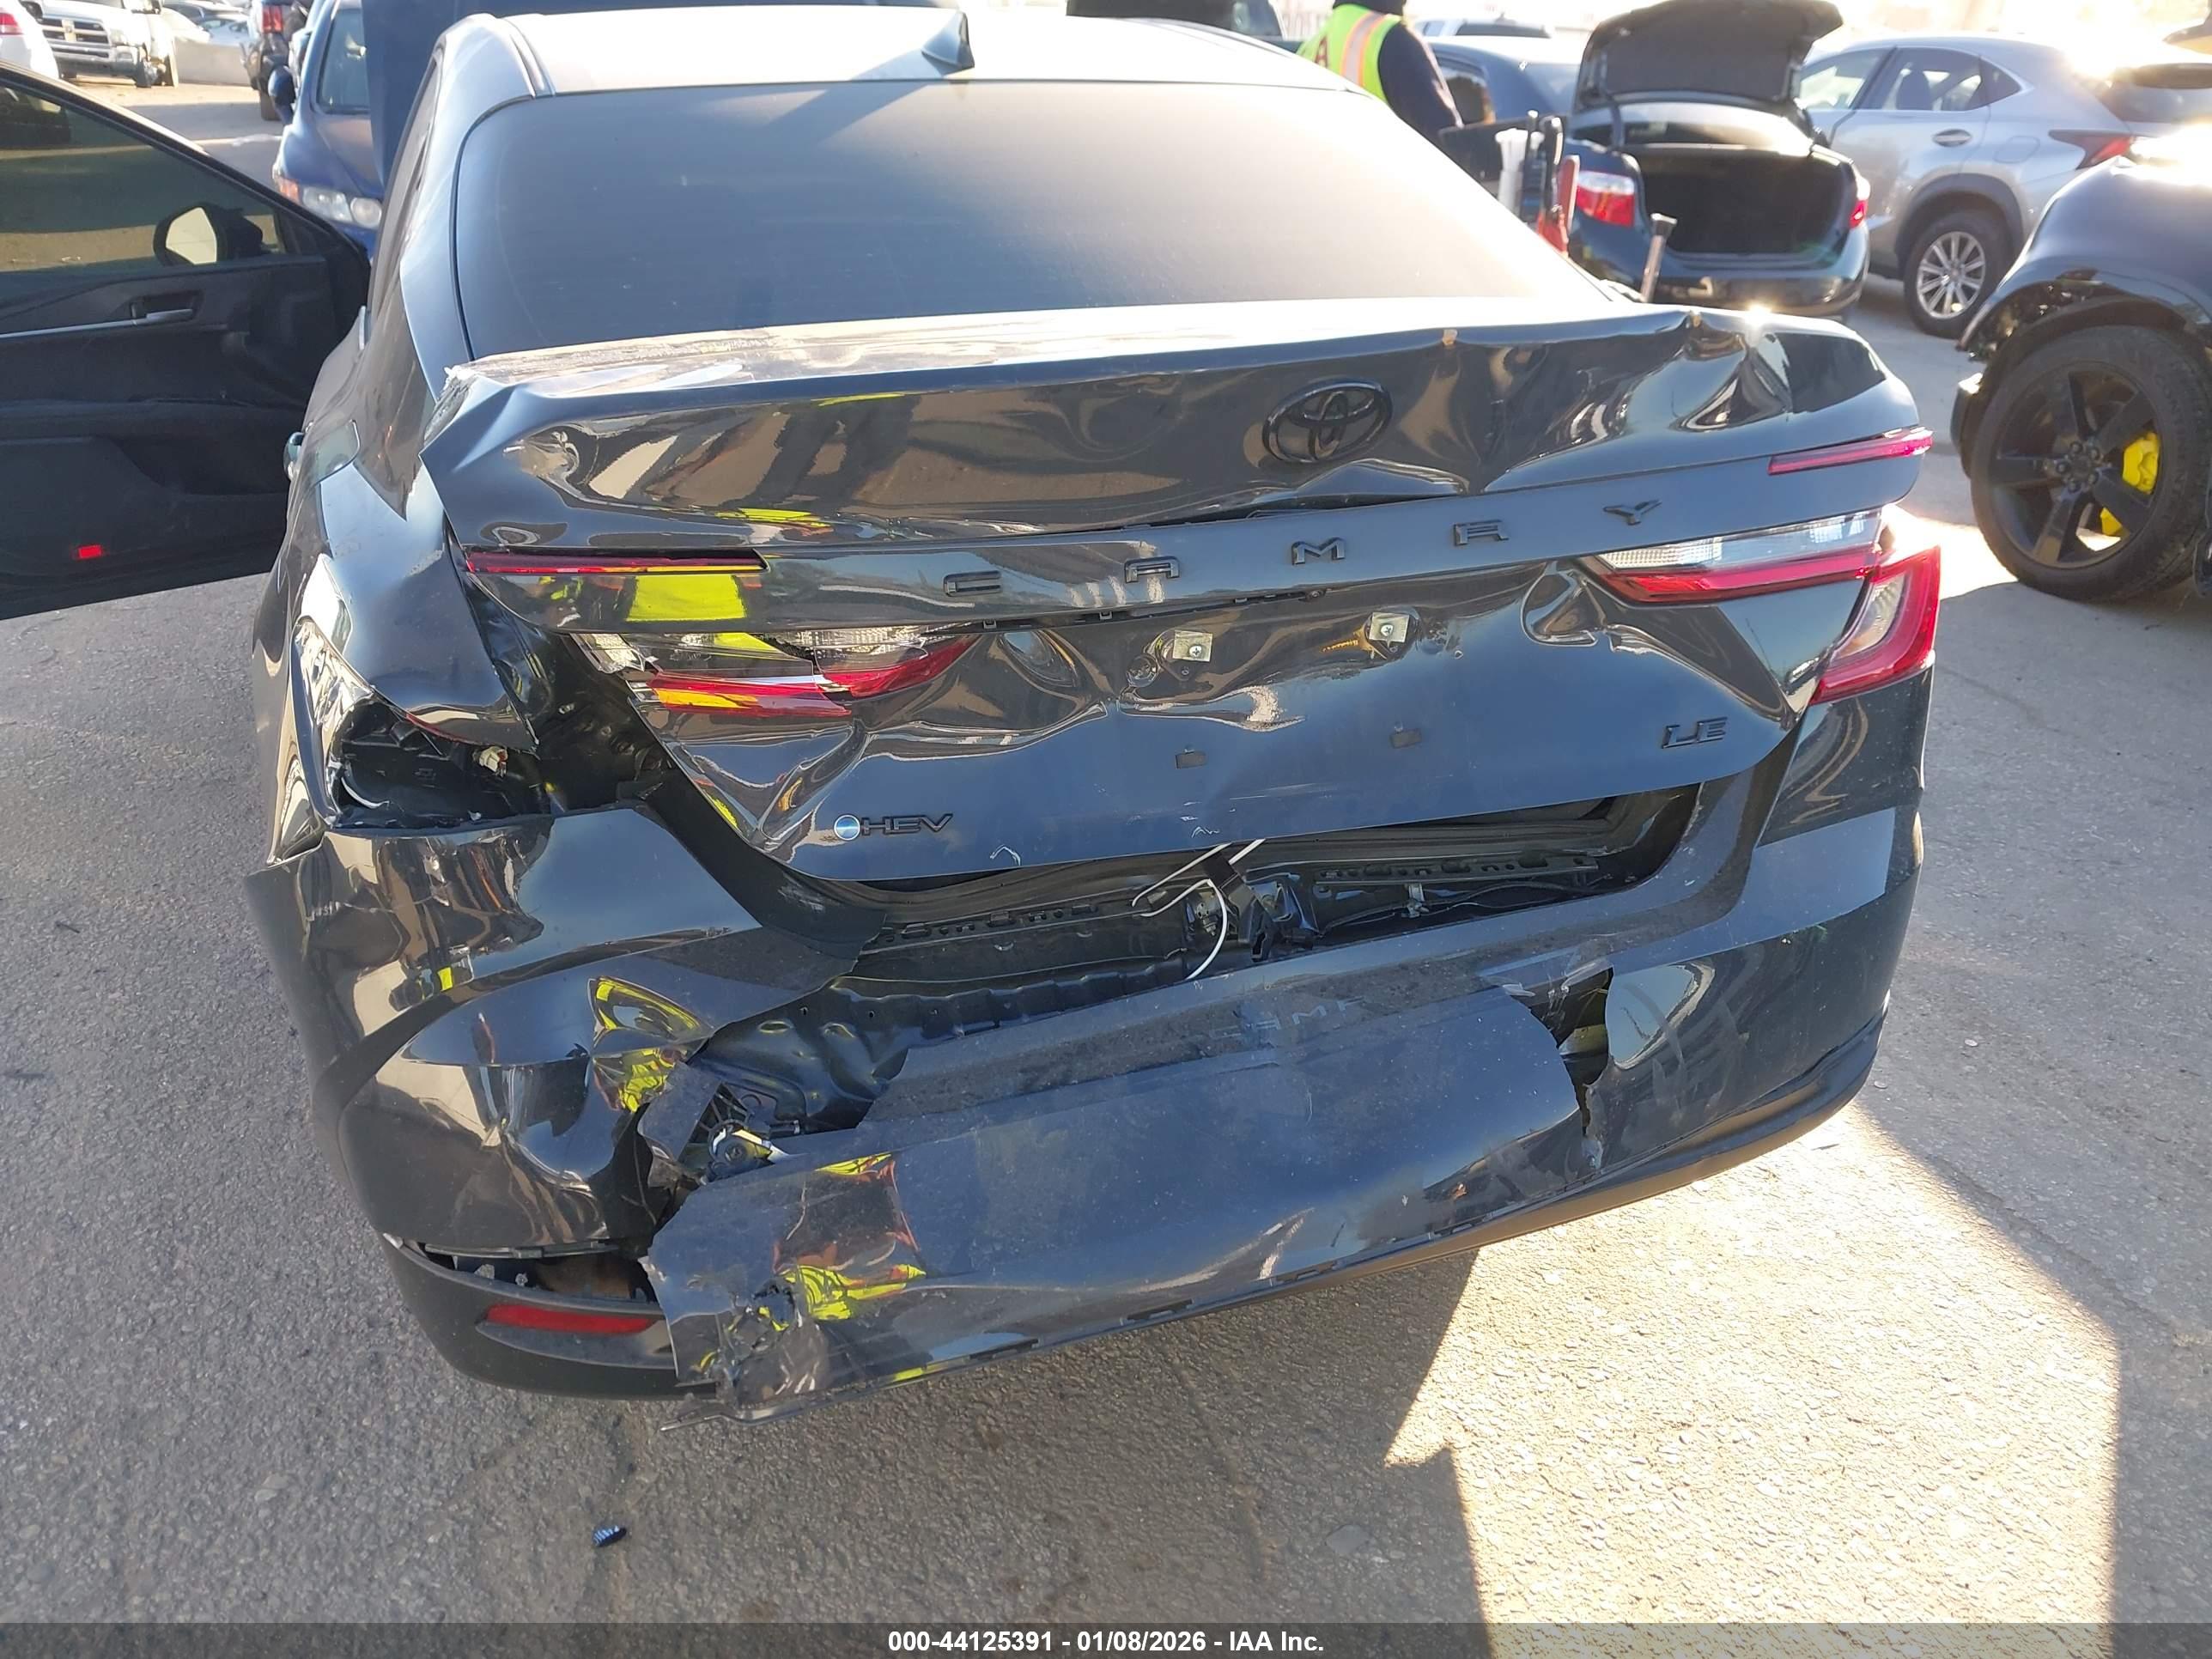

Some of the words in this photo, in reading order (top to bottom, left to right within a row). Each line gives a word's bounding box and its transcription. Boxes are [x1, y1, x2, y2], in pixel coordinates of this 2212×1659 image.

[943, 498, 1663, 598] CAMRY
[1661, 715, 1729, 750] LE
[860, 812, 953, 836] HEV
